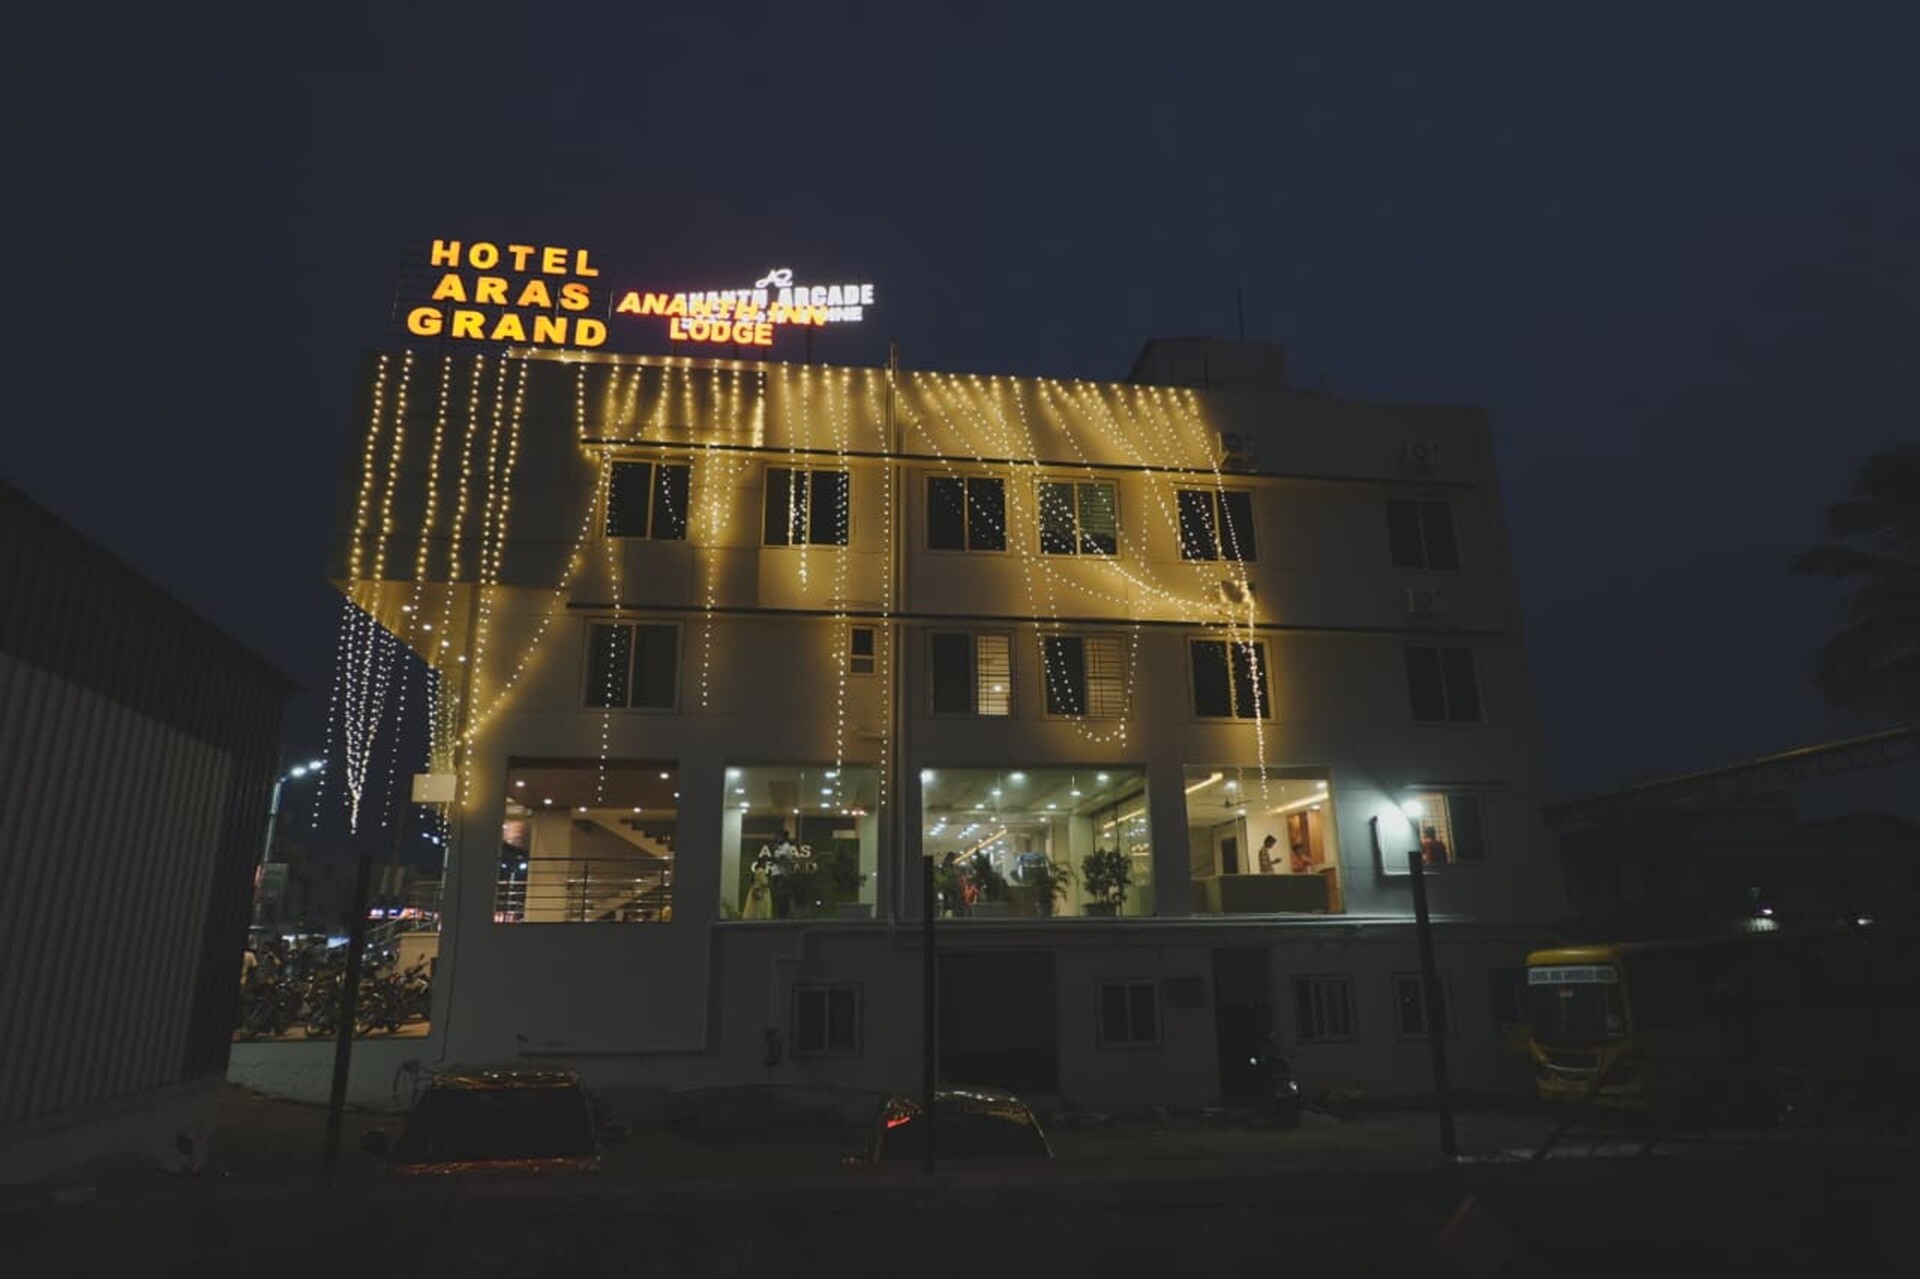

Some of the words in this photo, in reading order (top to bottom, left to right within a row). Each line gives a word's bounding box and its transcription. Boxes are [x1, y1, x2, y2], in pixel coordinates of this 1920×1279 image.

[430, 239, 600, 277] HOTEL
[431, 272, 592, 311] ARAS
[616, 291, 760, 322] ANANTH
[768, 301, 829, 326] INN
[777, 284, 874, 307] ARCADE
[406, 306, 609, 347] GRAND
[669, 317, 774, 346] LODGE
